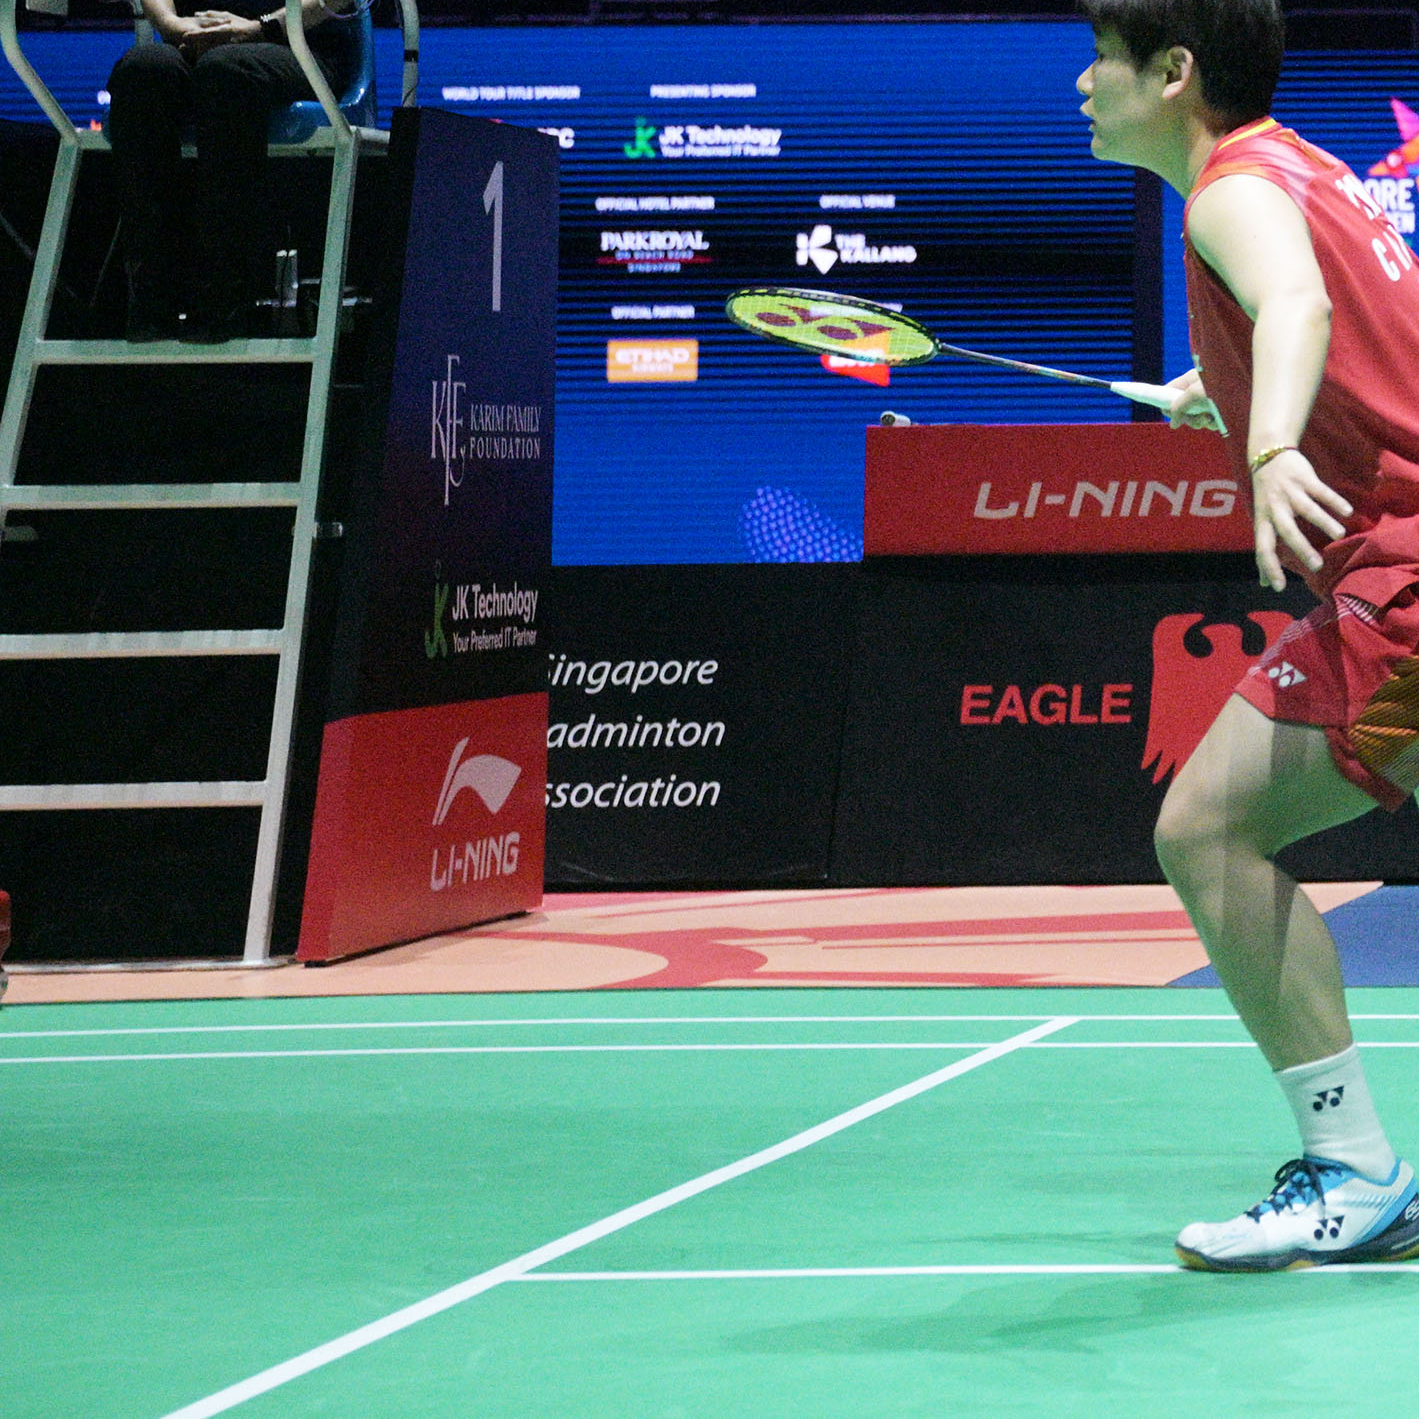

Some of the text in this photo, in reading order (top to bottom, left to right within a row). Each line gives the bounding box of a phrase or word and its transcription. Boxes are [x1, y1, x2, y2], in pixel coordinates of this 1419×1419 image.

[659, 125, 782, 147] JK Technology
[481, 161, 505, 312] 1
[601, 230, 710, 252] PARKROYAL
[839, 245, 918, 264] KALLANG
[615, 347, 690, 365] ETIHAD
[470, 403, 542, 433] KARIM FAMILY
[469, 436, 541, 460] FOUNDATION
[972, 480, 1239, 520] LI-NING
[452, 581, 539, 624] JK Technology
[453, 626, 537, 653] Your Preferred IT Partner
[548, 653, 719, 694] ingapore
[960, 684, 1133, 725] EAGLE
[546, 713, 726, 749] adminton
[430, 830, 520, 893] LI-NING
